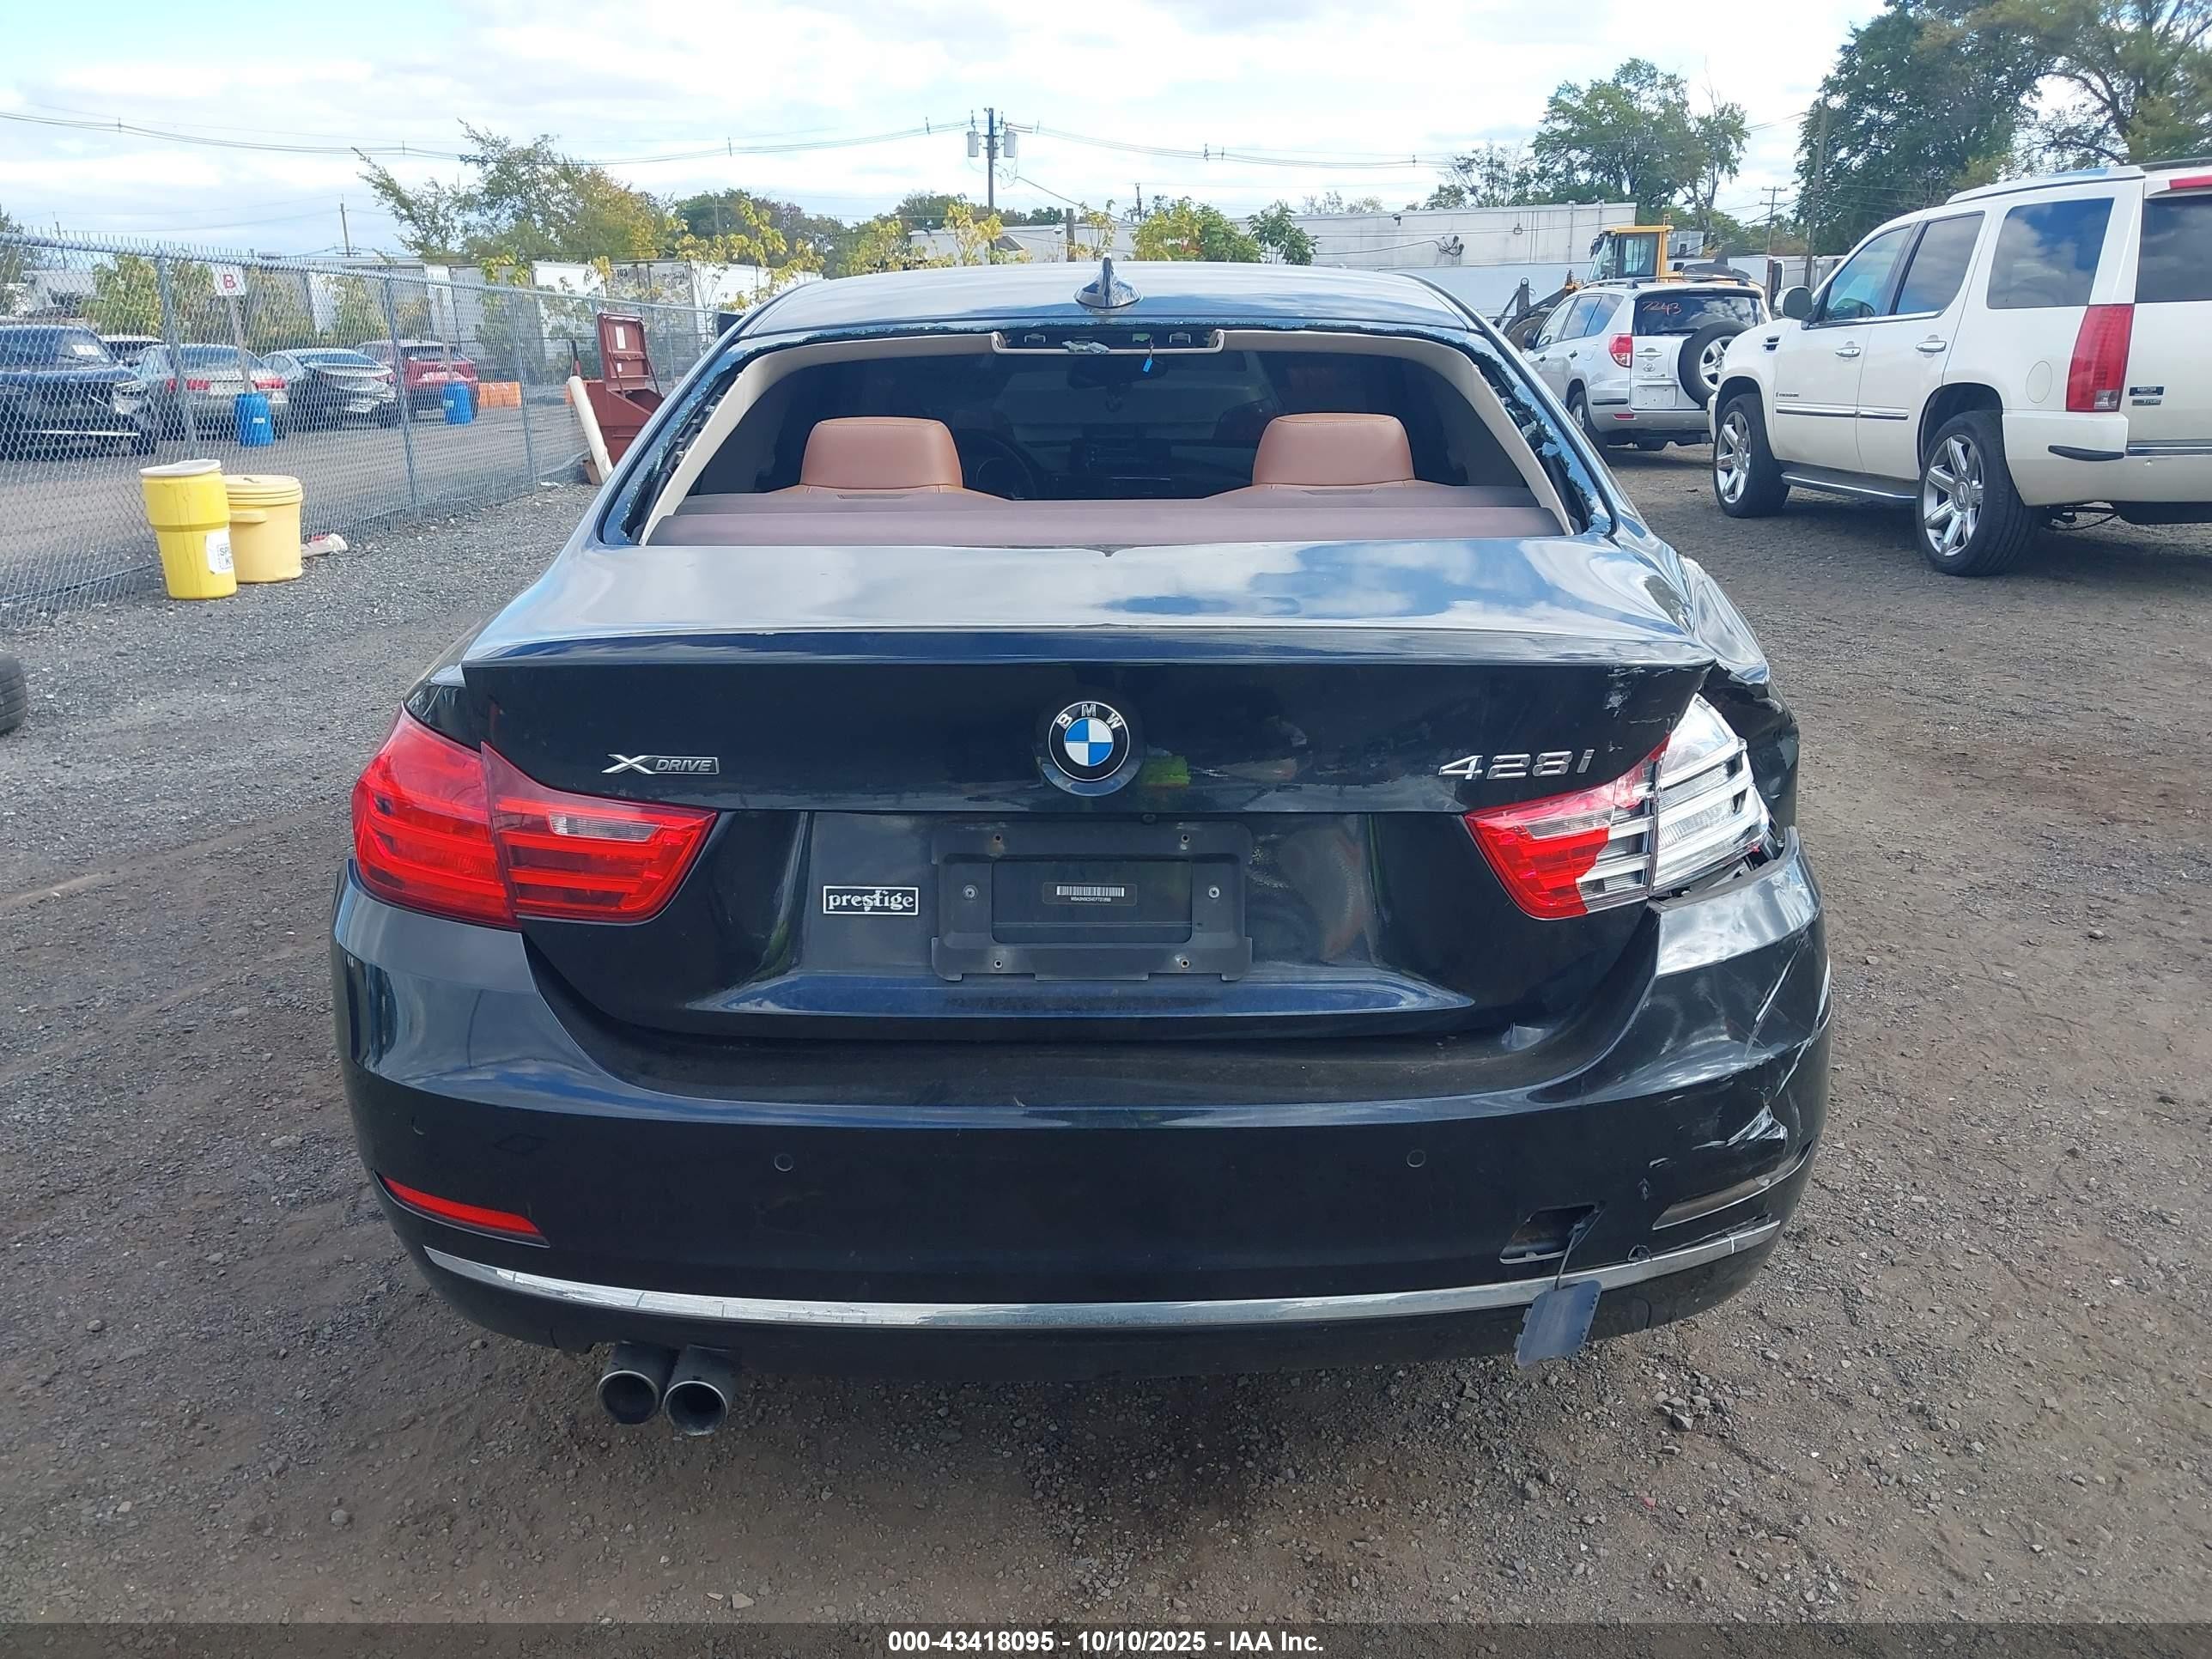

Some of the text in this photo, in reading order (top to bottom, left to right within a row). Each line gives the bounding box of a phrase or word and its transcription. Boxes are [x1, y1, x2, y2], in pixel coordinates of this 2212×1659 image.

[1056, 703, 1123, 730] BMW
[1438, 749, 1595, 781] 428i
[828, 890, 915, 912] prestige
